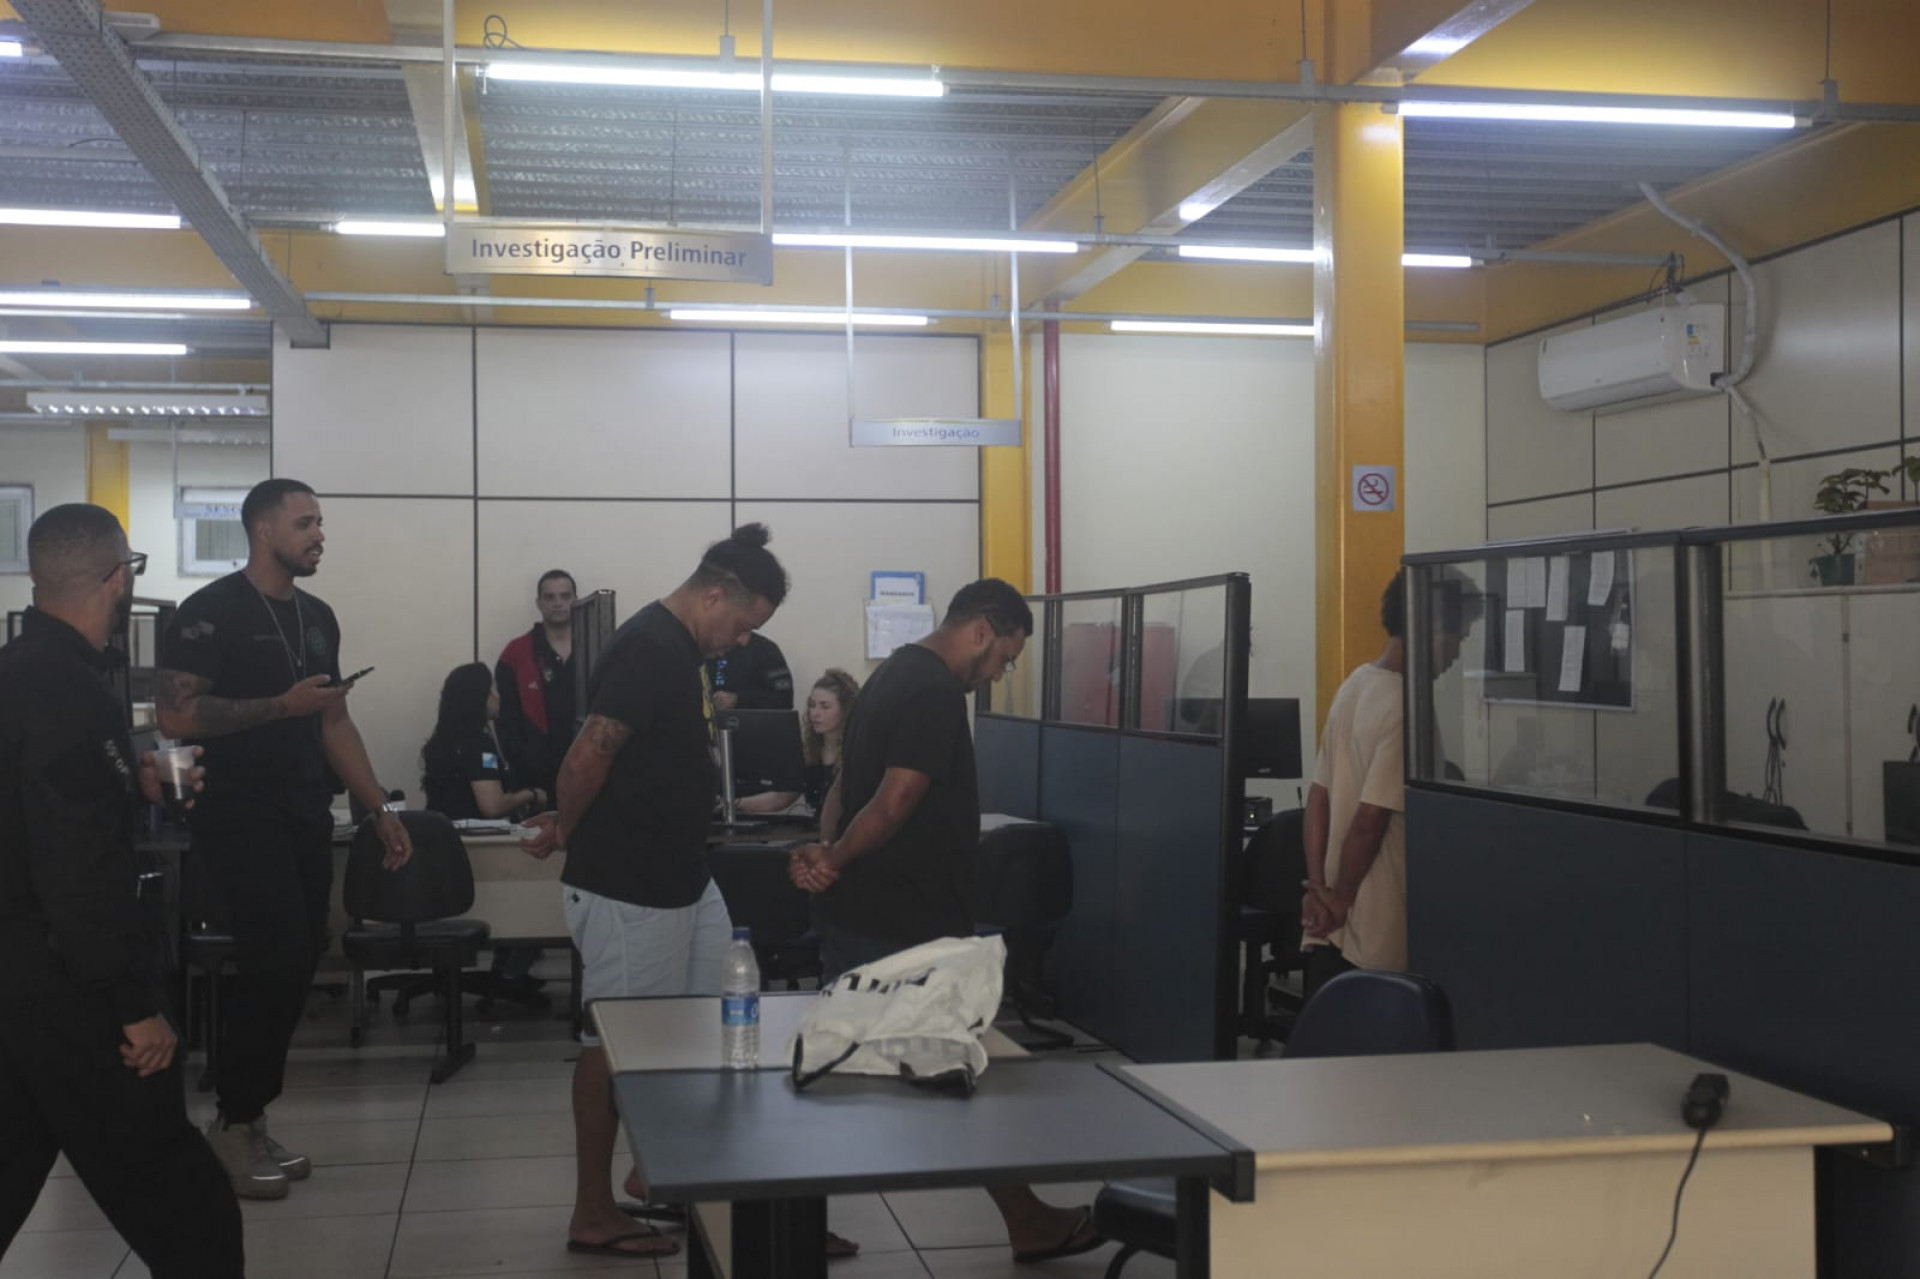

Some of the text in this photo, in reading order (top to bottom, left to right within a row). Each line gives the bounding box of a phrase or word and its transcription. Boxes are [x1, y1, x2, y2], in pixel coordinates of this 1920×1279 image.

[472, 238, 747, 266] Investigação Preliminar
[892, 426, 980, 440] Investigação
